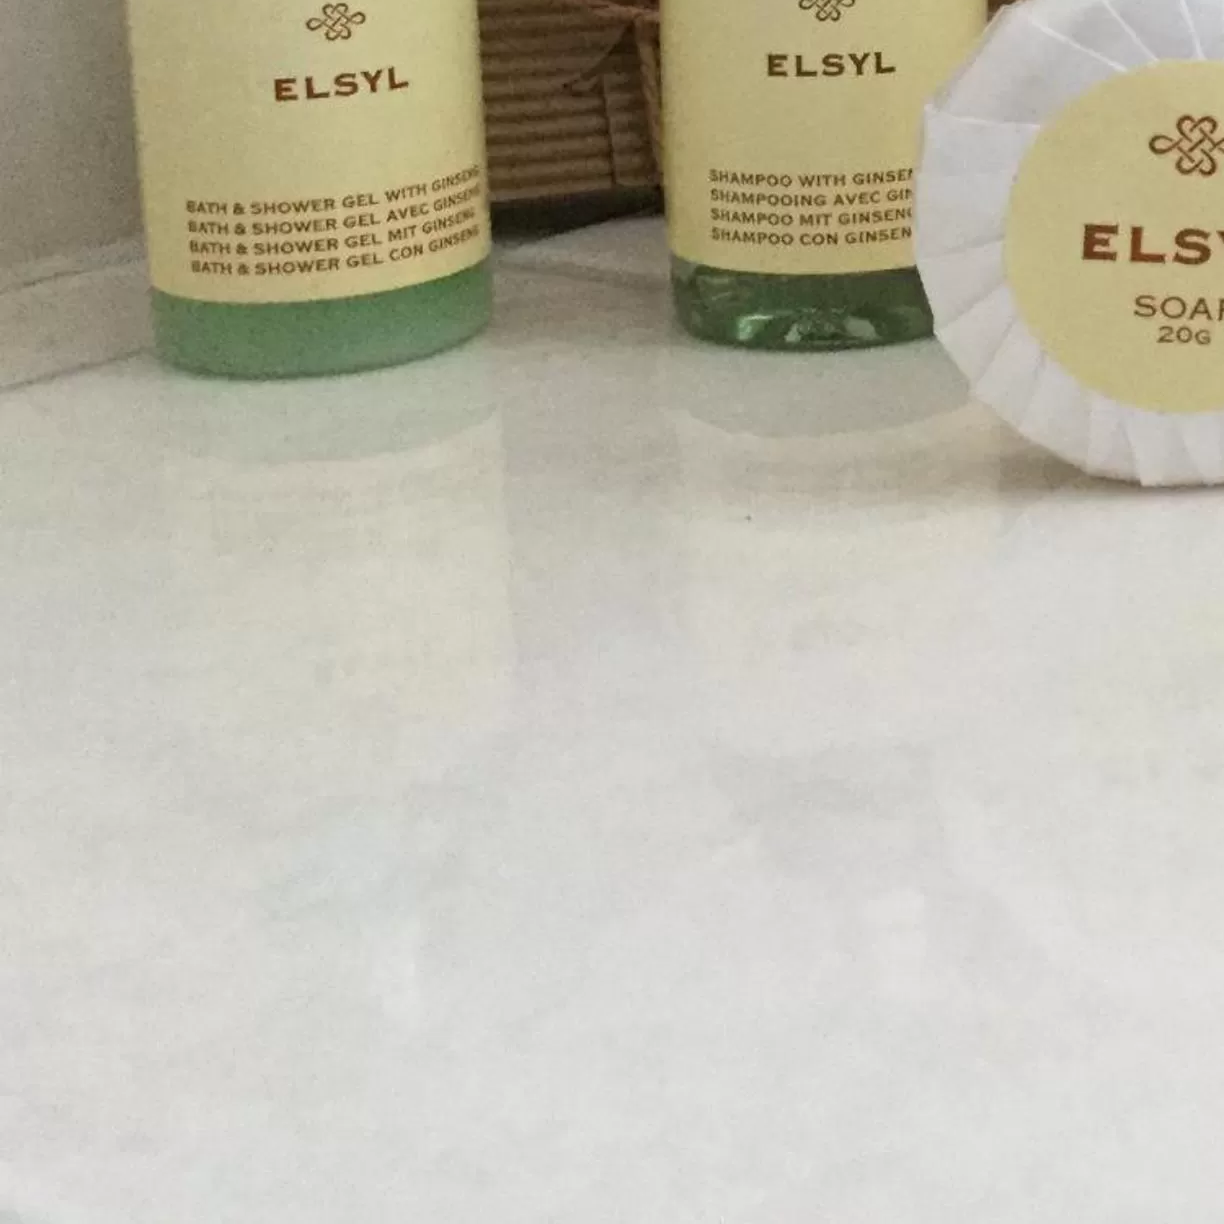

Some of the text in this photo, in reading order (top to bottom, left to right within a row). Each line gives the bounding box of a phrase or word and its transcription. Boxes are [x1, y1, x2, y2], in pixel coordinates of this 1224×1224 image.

[767, 51, 896, 77] ELSYL
[273, 66, 409, 102] ELSYL
[708, 169, 792, 187] SHAMPOO
[798, 174, 845, 187] WITH
[186, 199, 227, 214] BATH
[233, 203, 245, 214] &
[250, 198, 335, 214] SHOWER
[342, 194, 379, 209] GEL
[385, 183, 427, 203] WITH
[710, 188, 826, 207] SHAMPOOING
[834, 191, 880, 206] AVEC
[188, 221, 229, 235] BATH
[235, 224, 247, 235] &
[252, 218, 336, 235] SHOWER
[344, 214, 381, 230] GEL
[386, 203, 429, 222] AVEC
[711, 208, 793, 226] SHAMPOO
[800, 213, 832, 226] MIT
[189, 240, 231, 255] BATH
[236, 243, 248, 255] &
[254, 239, 338, 255] SHOWER
[345, 235, 382, 250] GEL
[388, 224, 418, 242] MIT
[711, 227, 912, 245] SHAMPOO CON GINSEN
[191, 261, 233, 275] BATH
[238, 263, 250, 275] &
[256, 259, 340, 276] SHOWER
[346, 254, 383, 269] GEL
[389, 243, 423, 260] CON
[1157, 326, 1211, 345] 20G
